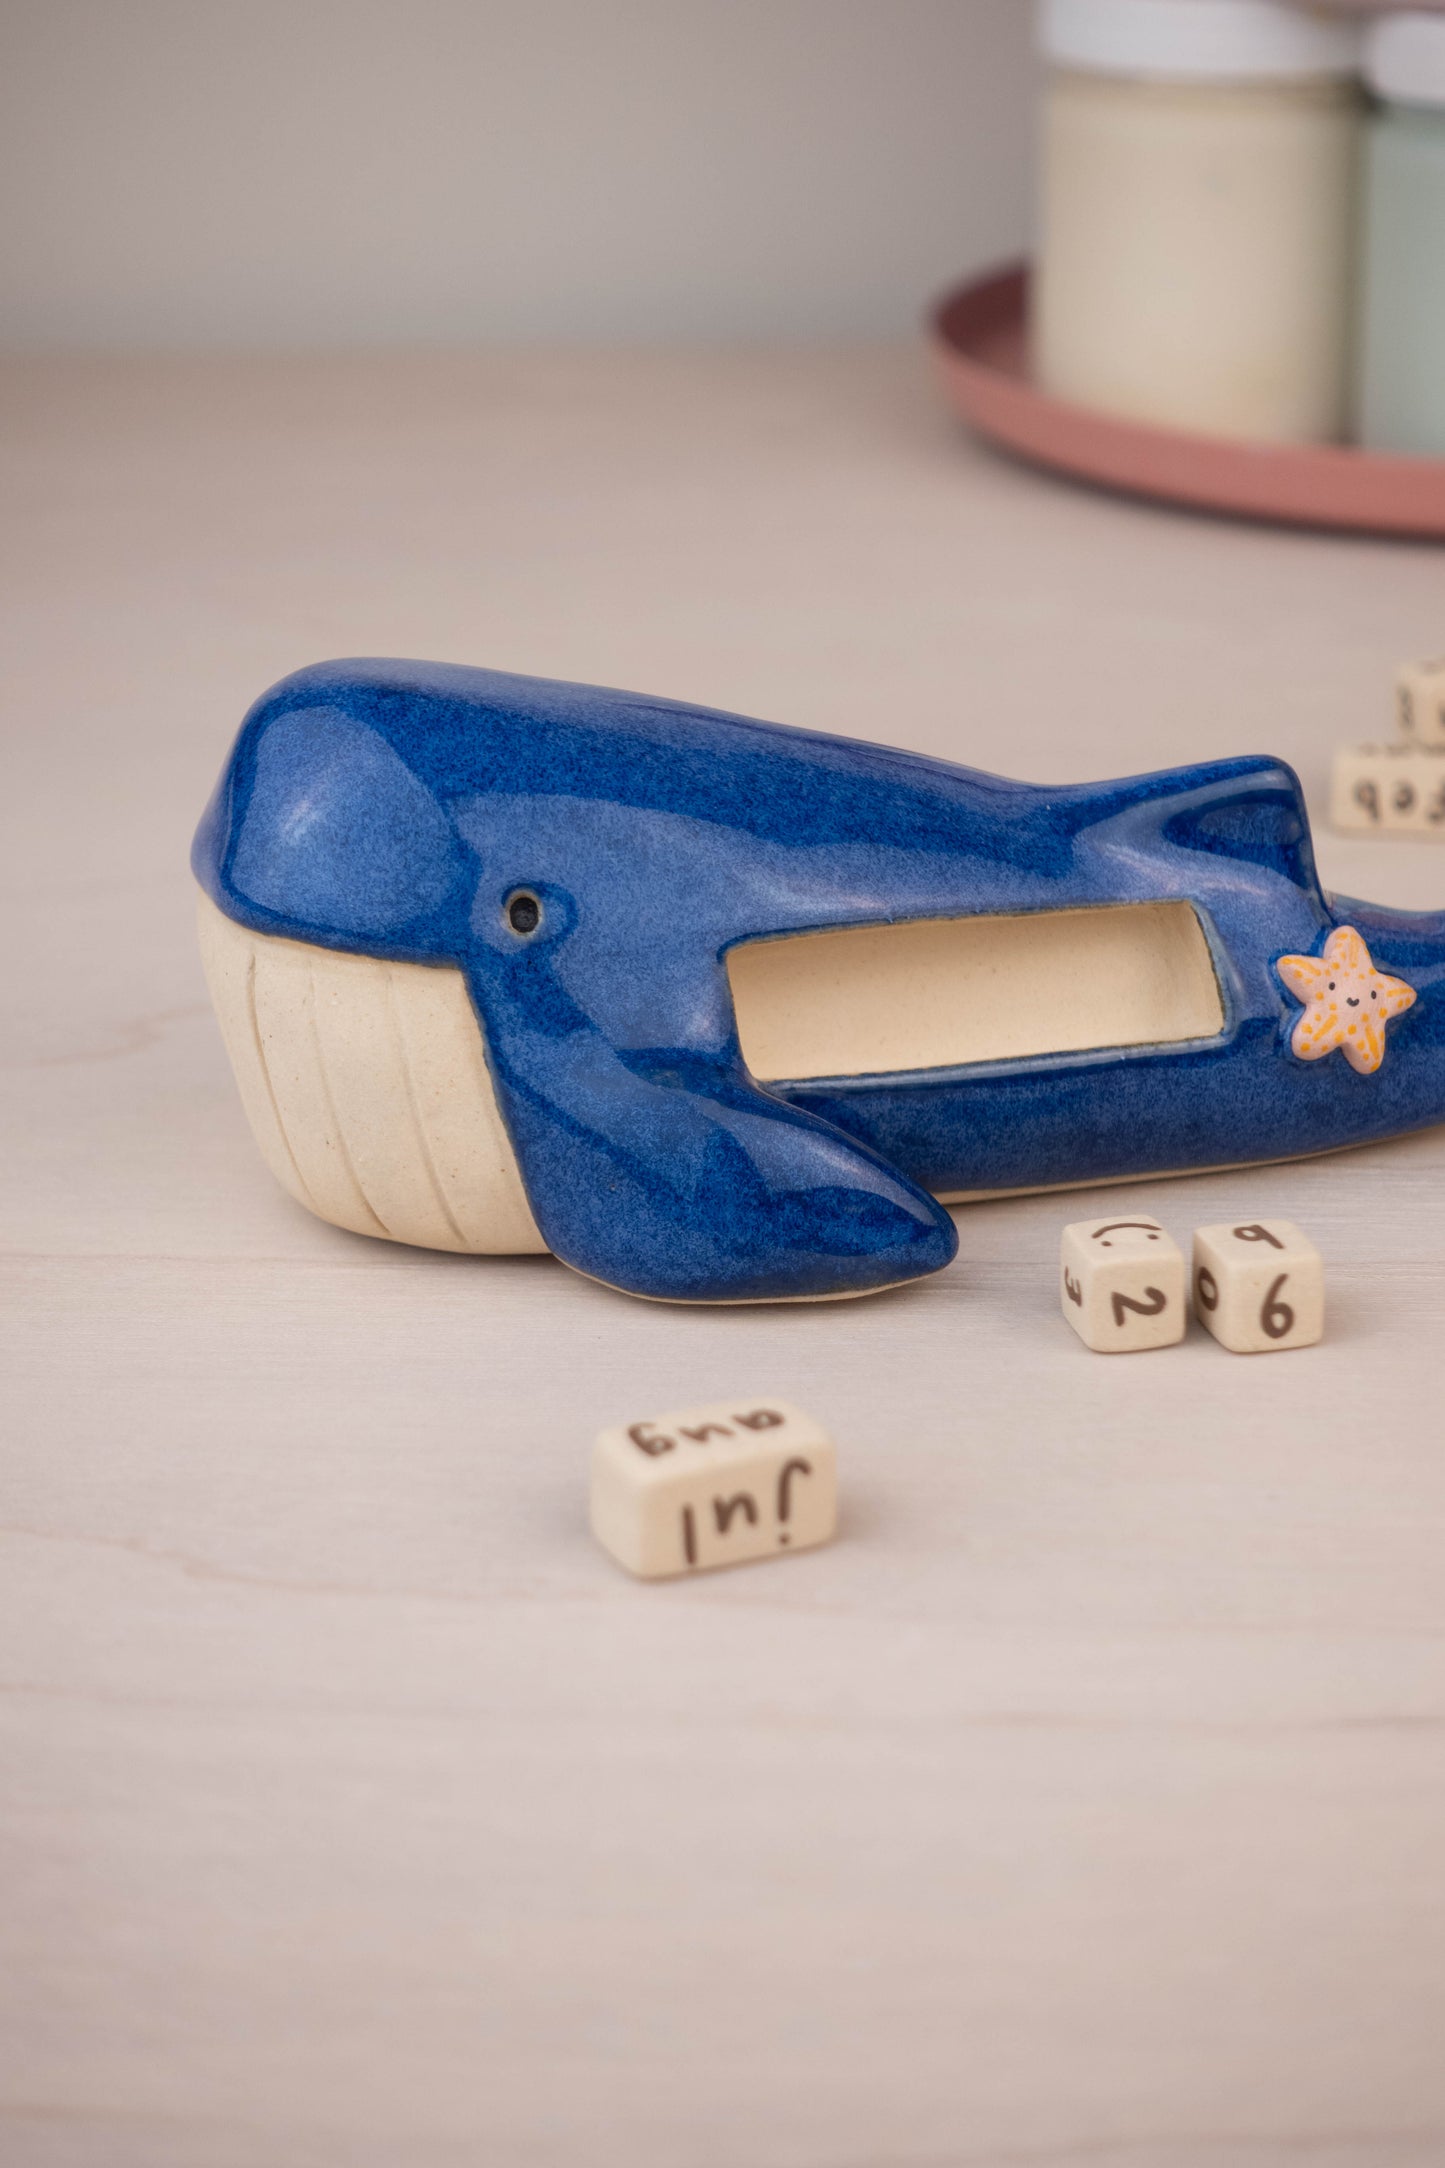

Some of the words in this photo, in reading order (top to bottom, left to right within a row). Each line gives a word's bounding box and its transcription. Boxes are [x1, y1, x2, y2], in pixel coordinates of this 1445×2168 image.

[1111, 1285, 1167, 1328] 2
[1260, 1272, 1295, 1340] 6
[627, 1408, 785, 1457] aug
[681, 1456, 813, 1567] jul
